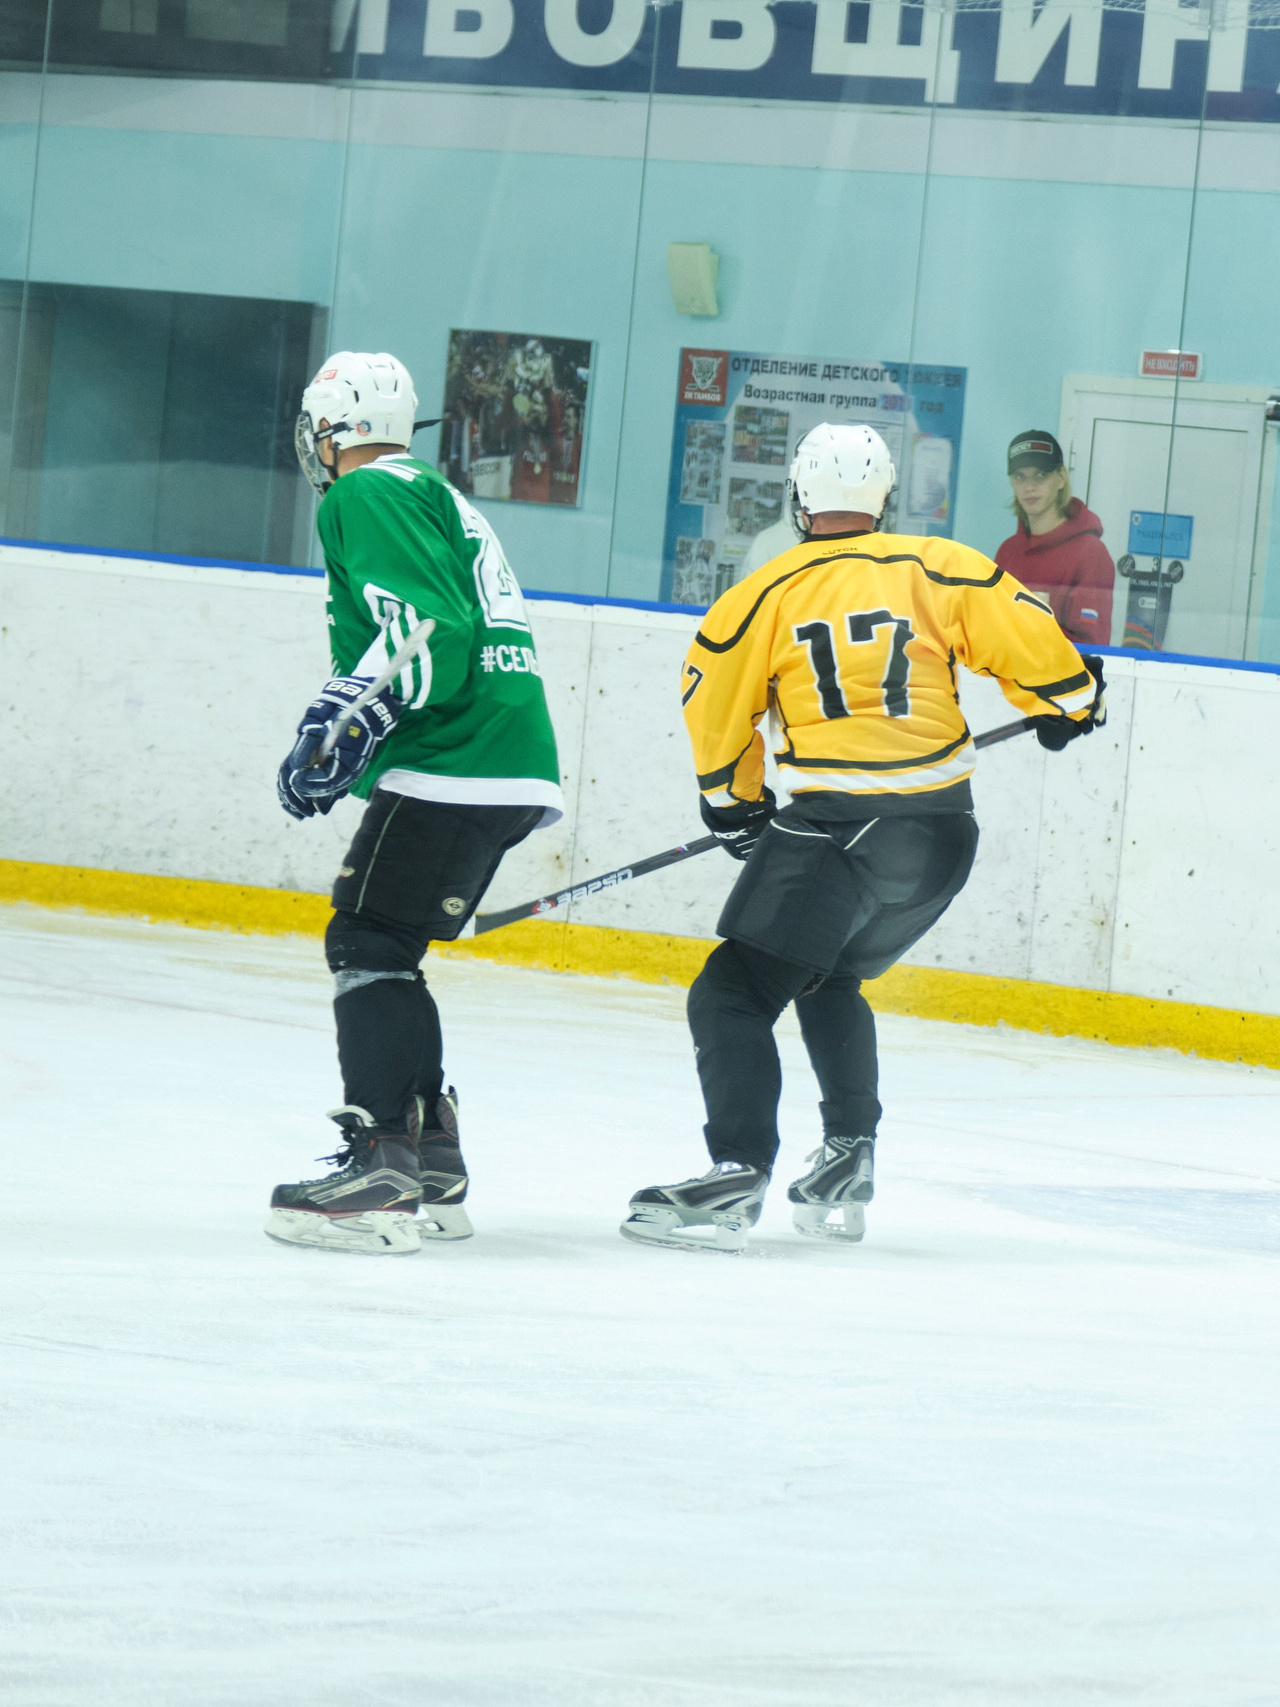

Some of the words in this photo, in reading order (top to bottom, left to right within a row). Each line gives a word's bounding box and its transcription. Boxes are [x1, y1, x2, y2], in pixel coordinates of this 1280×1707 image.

[731, 356, 817, 379] ОТДЕЛЕНИЕ
[821, 363, 900, 385] ДЕТСКОГО
[905, 367, 963, 388] ОККЕЯ
[1145, 357, 1155, 370] НЕ
[1157, 358, 1195, 371] ВХОДИТЬ
[744, 384, 825, 406] Возрастная
[829, 393, 877, 411] группа
[794, 607, 915, 719] 17
[680, 657, 705, 709] 7
